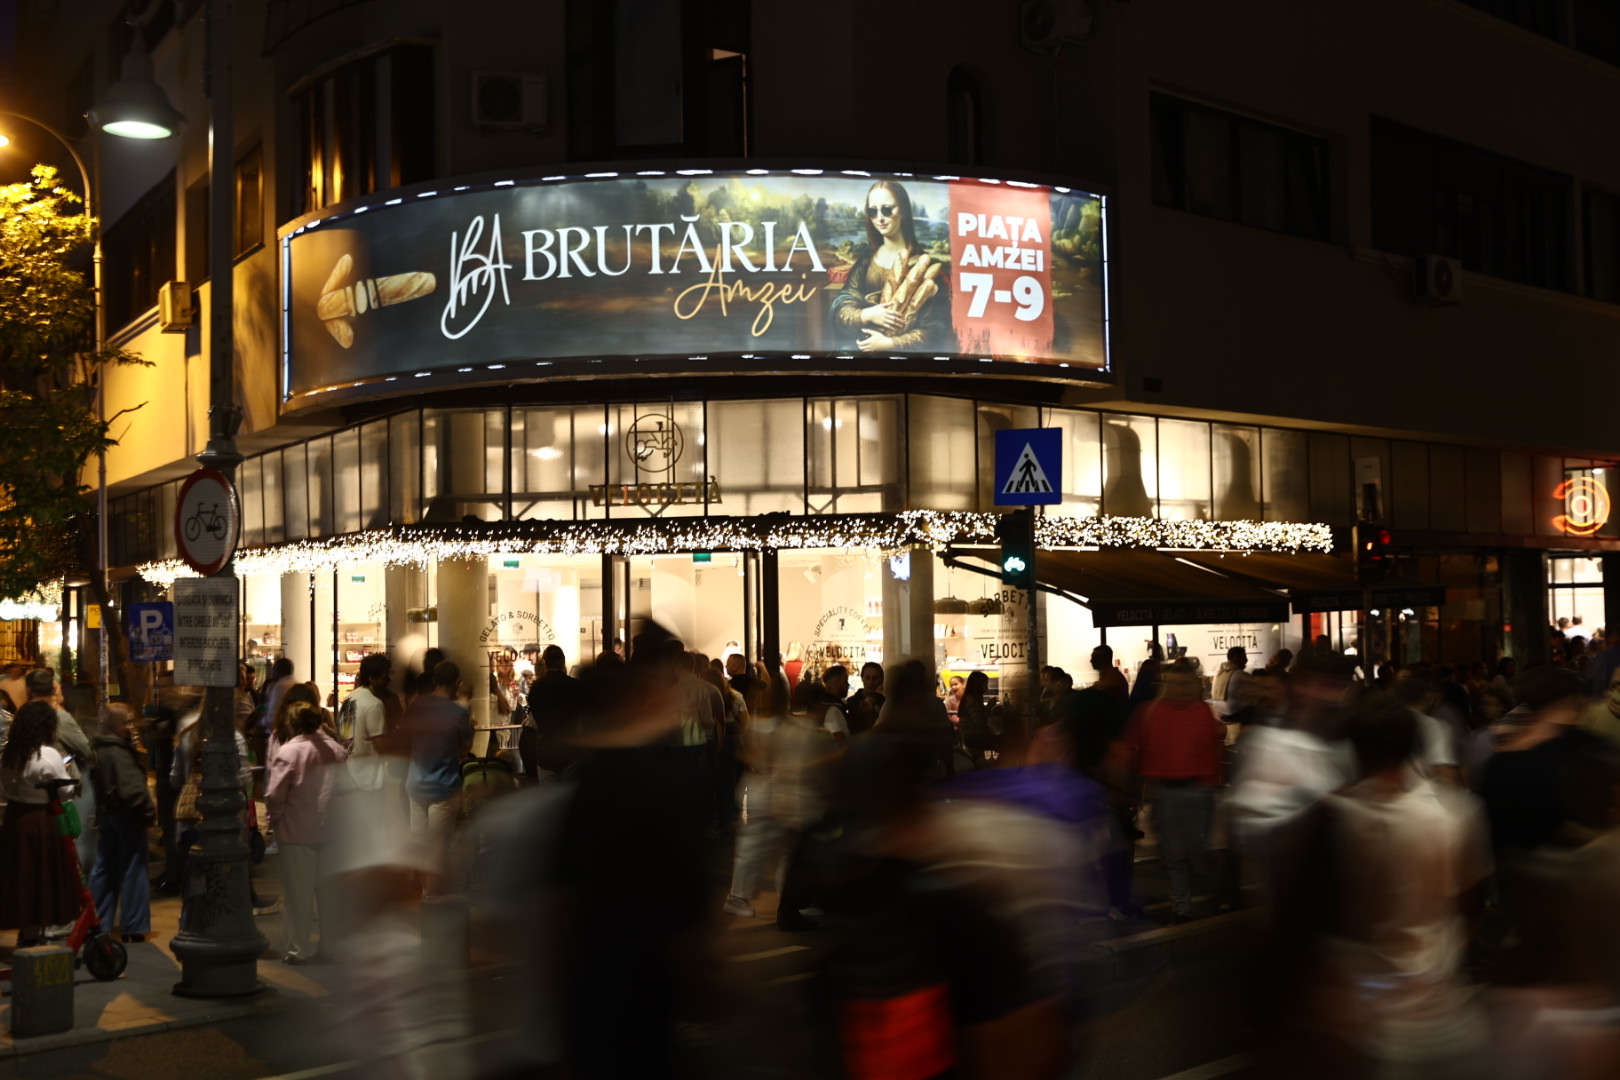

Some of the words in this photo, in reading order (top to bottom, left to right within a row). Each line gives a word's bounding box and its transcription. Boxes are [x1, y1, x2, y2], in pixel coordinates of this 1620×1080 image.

[521, 214, 828, 281] BRUTĂRIA
[959, 243, 1044, 272] AMZEI
[674, 242, 817, 337] Amzei
[959, 271, 1045, 322] 7-9
[981, 590, 1028, 618] SORBET
[140, 609, 163, 647] P
[480, 614, 506, 643] GELATO
[508, 611, 514, 619] &
[517, 610, 555, 641] SORBETTO
[981, 643, 1028, 659] VELOCI
